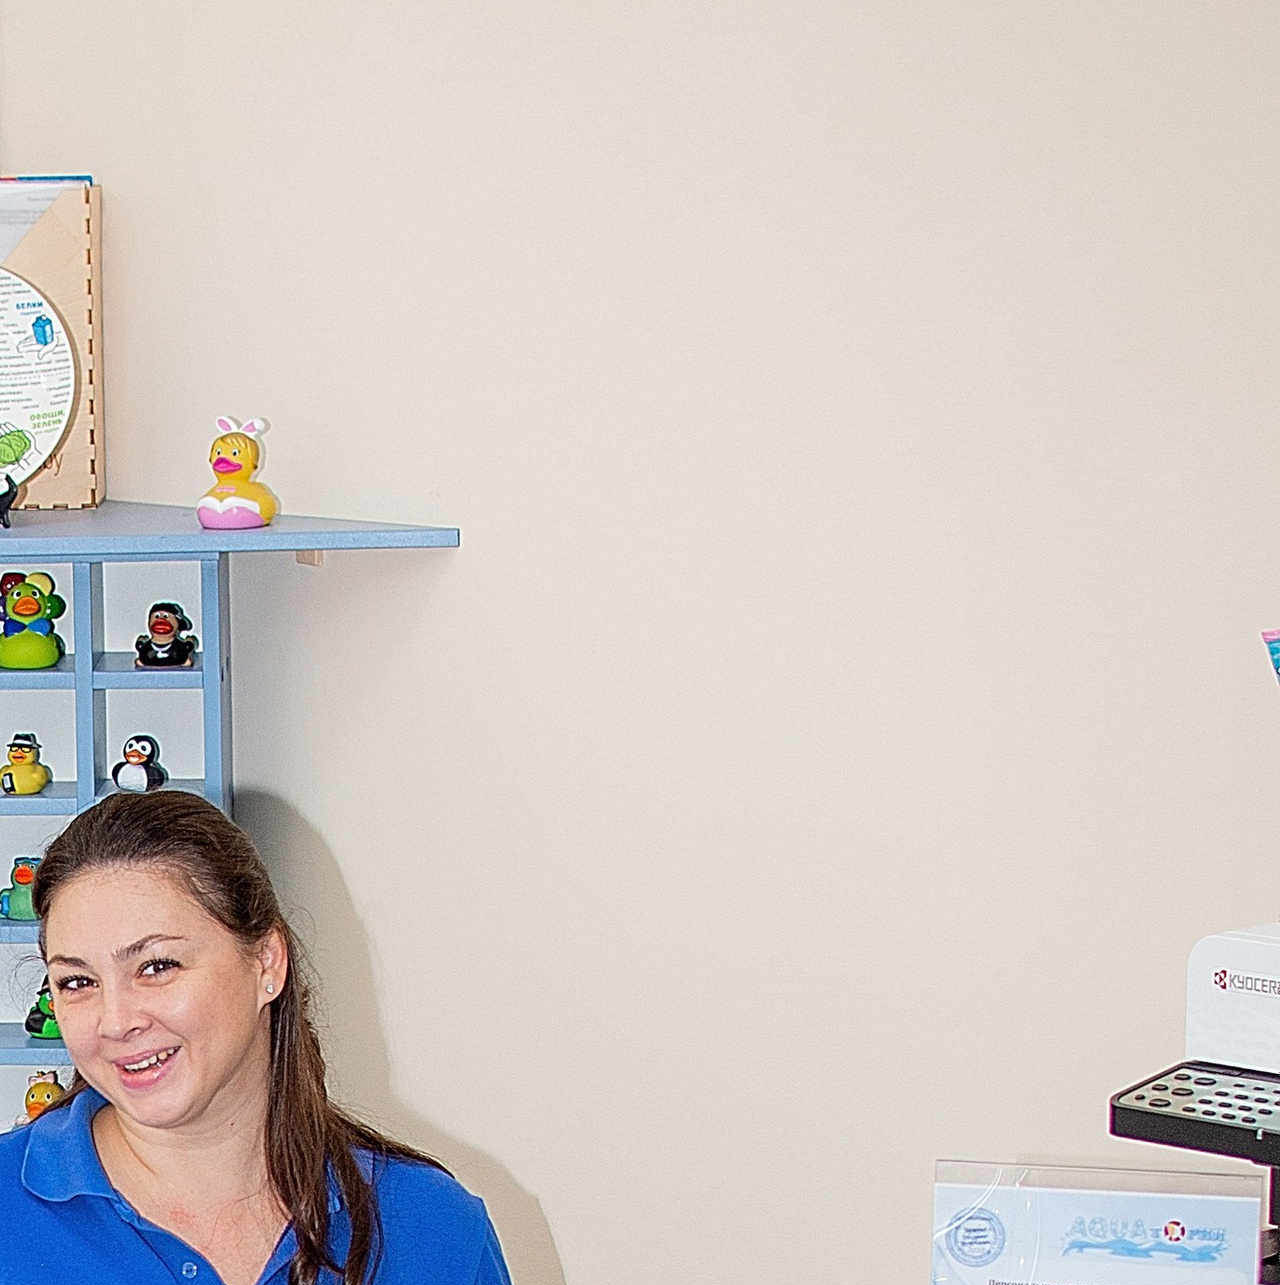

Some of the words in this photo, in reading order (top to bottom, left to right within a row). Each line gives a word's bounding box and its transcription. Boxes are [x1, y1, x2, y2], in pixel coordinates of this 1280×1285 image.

[16, 302, 43, 310] БЕЛКИ
[30, 410, 65, 421] ОВОЩИ,
[31, 419, 62, 429] ЗЕЛЕНЬ
